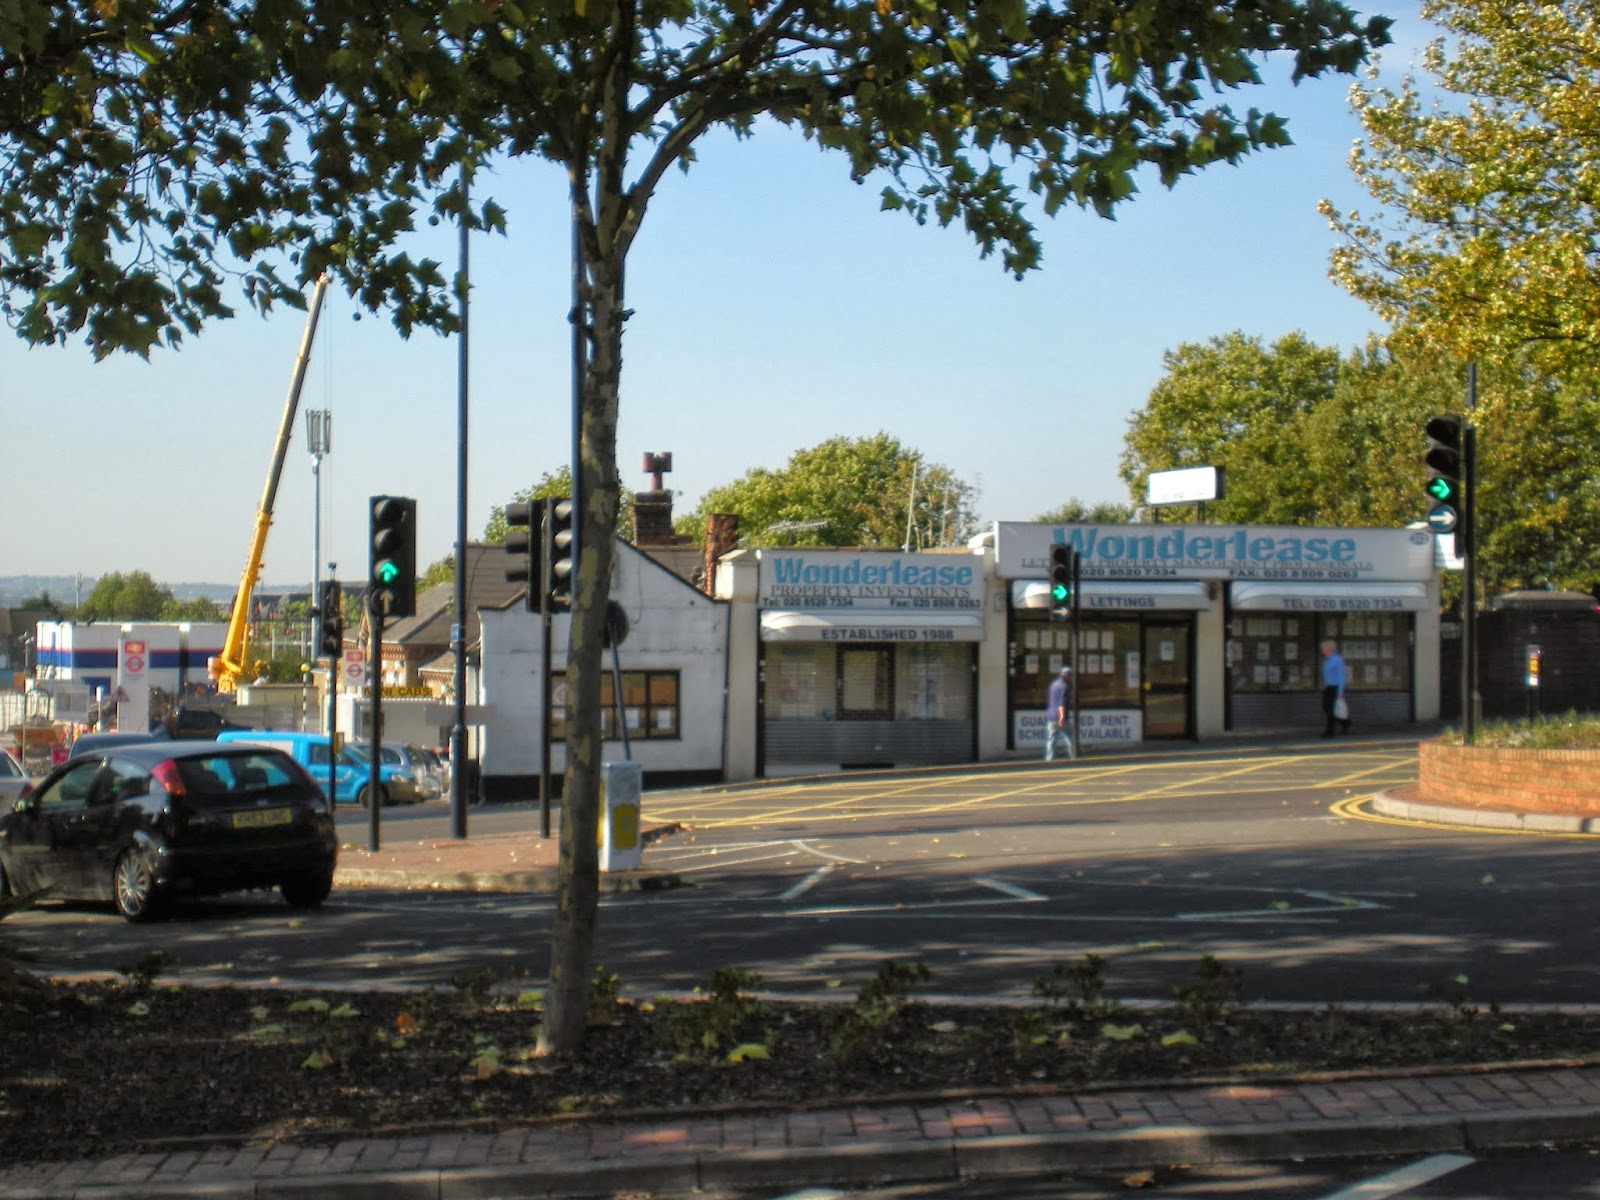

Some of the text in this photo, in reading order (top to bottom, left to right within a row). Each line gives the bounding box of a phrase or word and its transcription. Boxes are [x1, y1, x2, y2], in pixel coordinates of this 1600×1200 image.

[1052, 528, 1357, 562] Wonderlease
[773, 558, 973, 586] Wonderlease
[1145, 568, 1177, 577] 7334
[1264, 570, 1288, 578] 020
[771, 585, 970, 598] PROPERTY INVESTMENTS
[1090, 596, 1156, 608] LETTINGS
[1283, 598, 1404, 609] TEL: 020 8520 7334
[821, 628, 954, 641] ESTABLISHED 1988
[364, 688, 393, 697] MNI
[1101, 714, 1129, 726] RENT
[1079, 726, 1132, 739] VAILABLE
